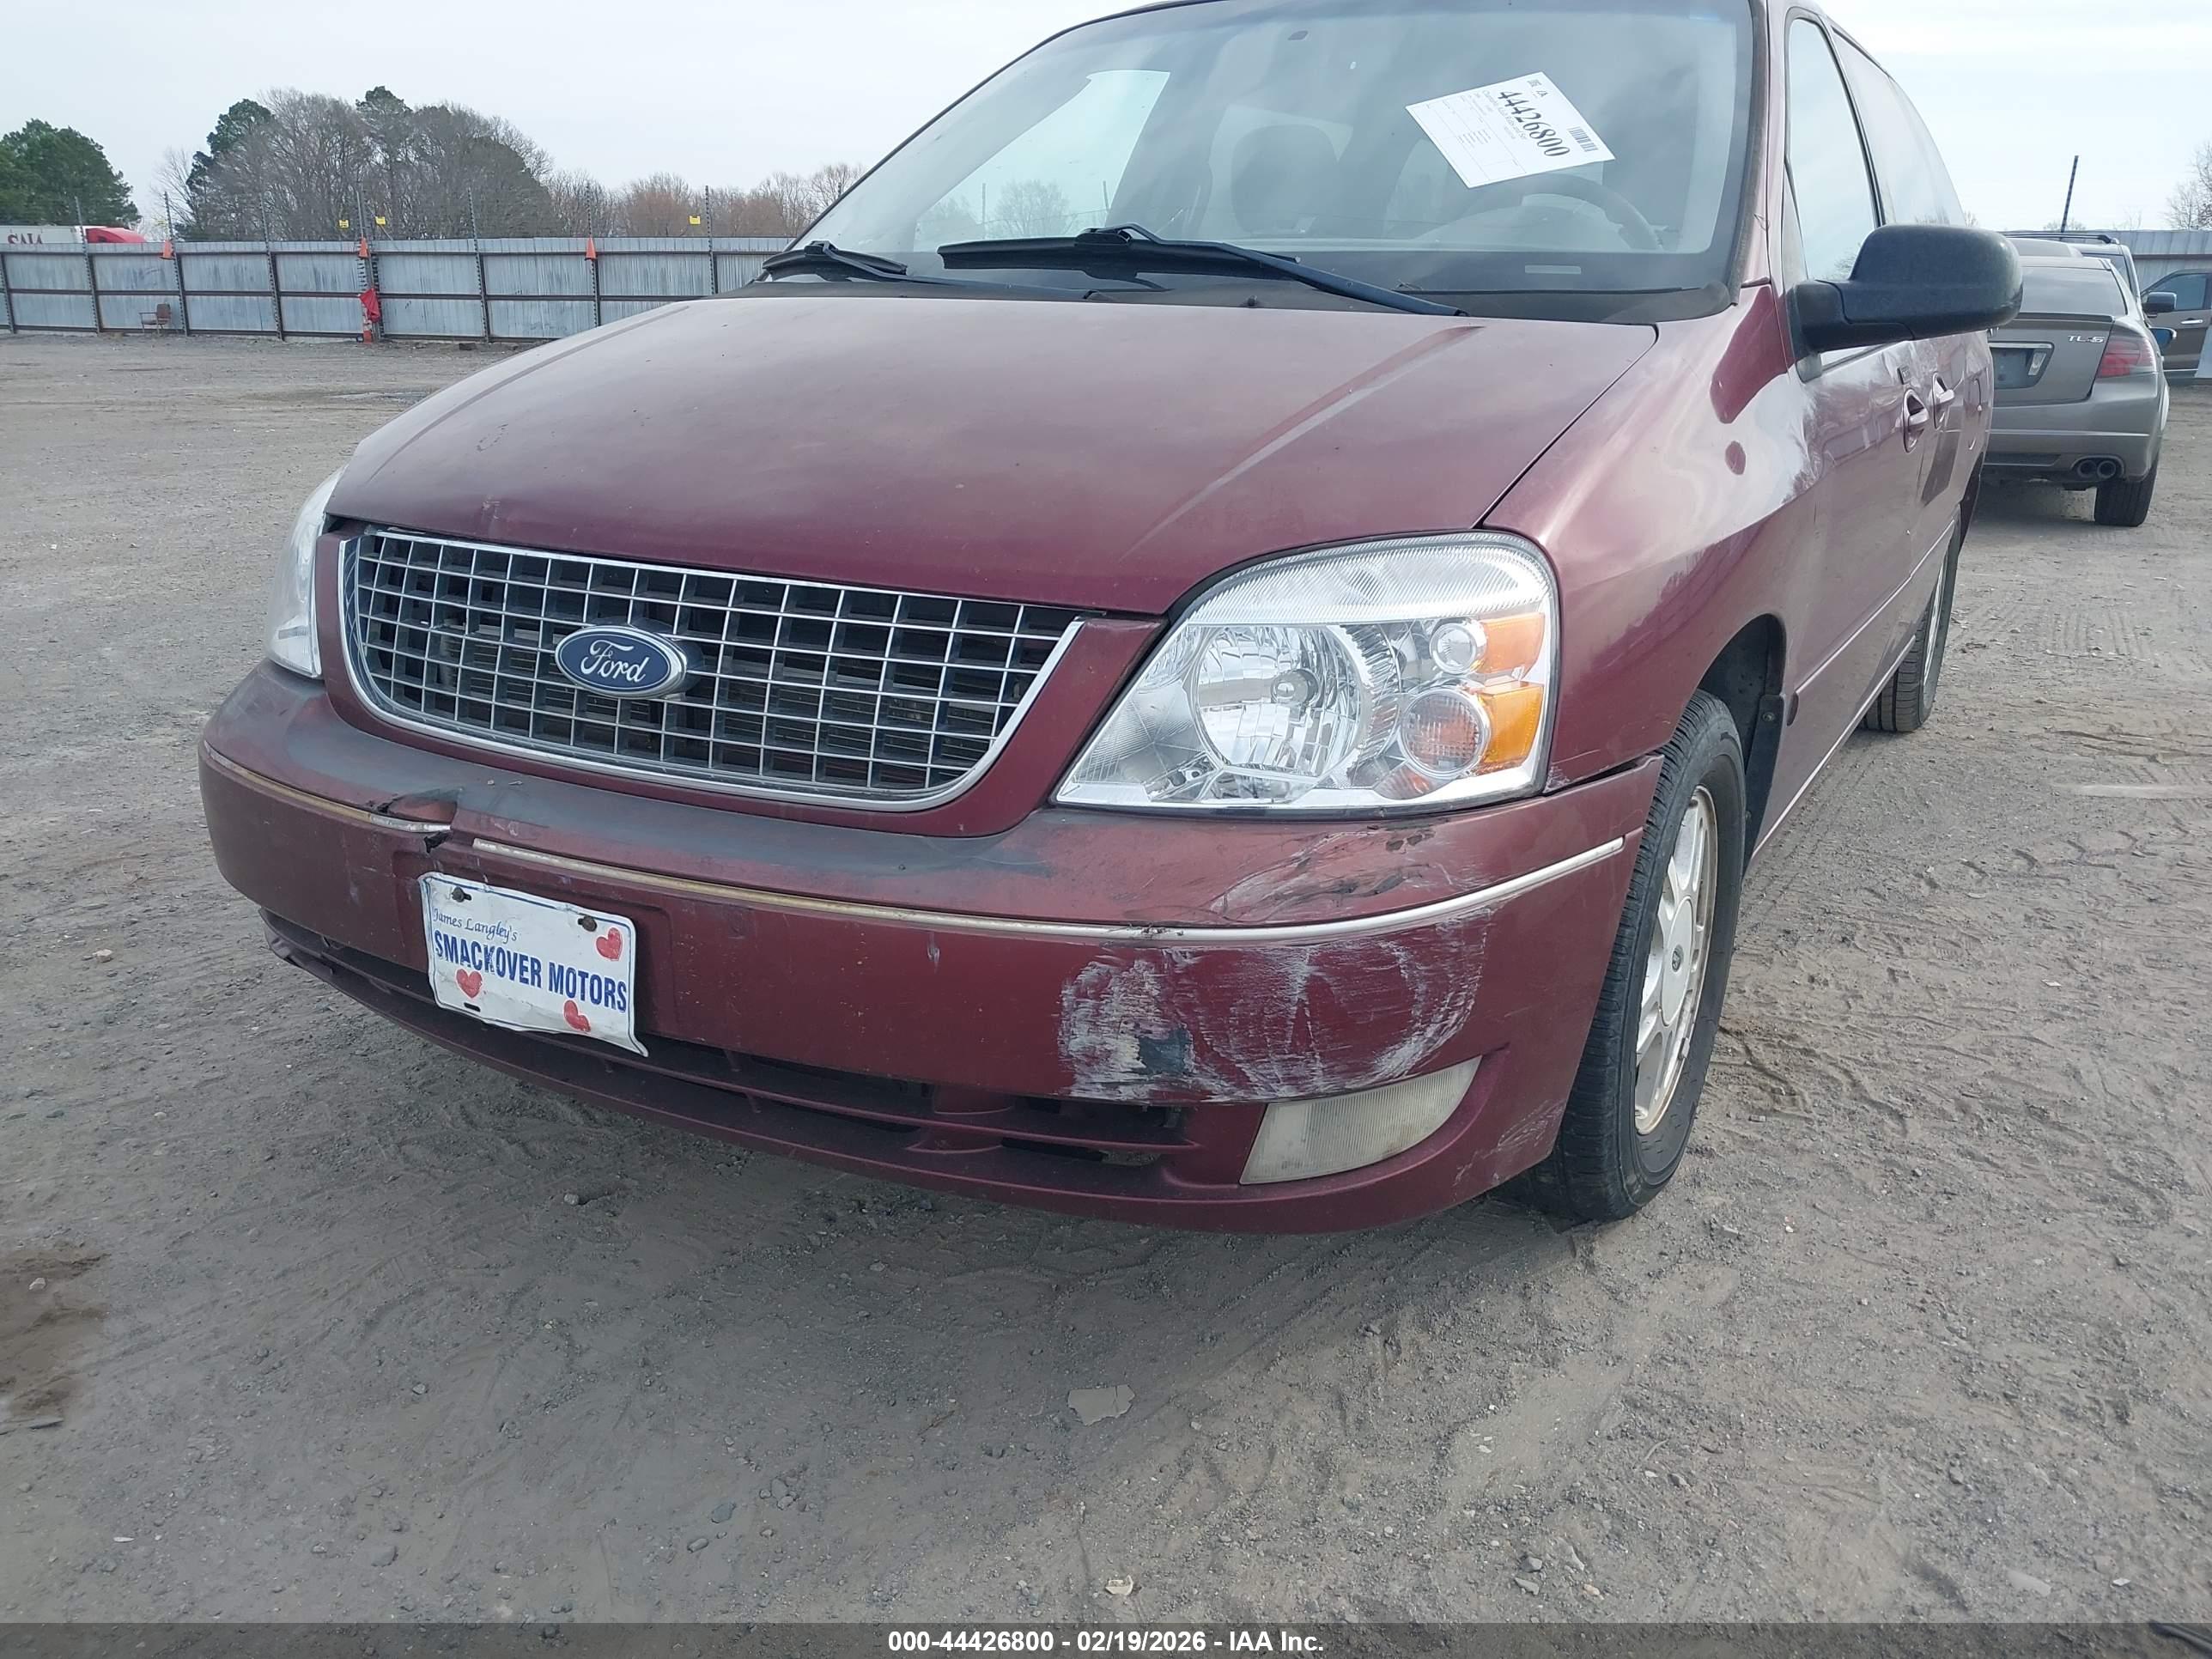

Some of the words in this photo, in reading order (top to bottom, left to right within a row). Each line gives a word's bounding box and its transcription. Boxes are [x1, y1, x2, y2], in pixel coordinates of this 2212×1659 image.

[1498, 91, 1571, 157] 44426800
[580, 639, 650, 683] Ford
[433, 908, 463, 928] James
[465, 917, 518, 945] Langley's
[434, 929, 543, 989] SMACKOVER
[548, 961, 628, 1013] MOTORS
